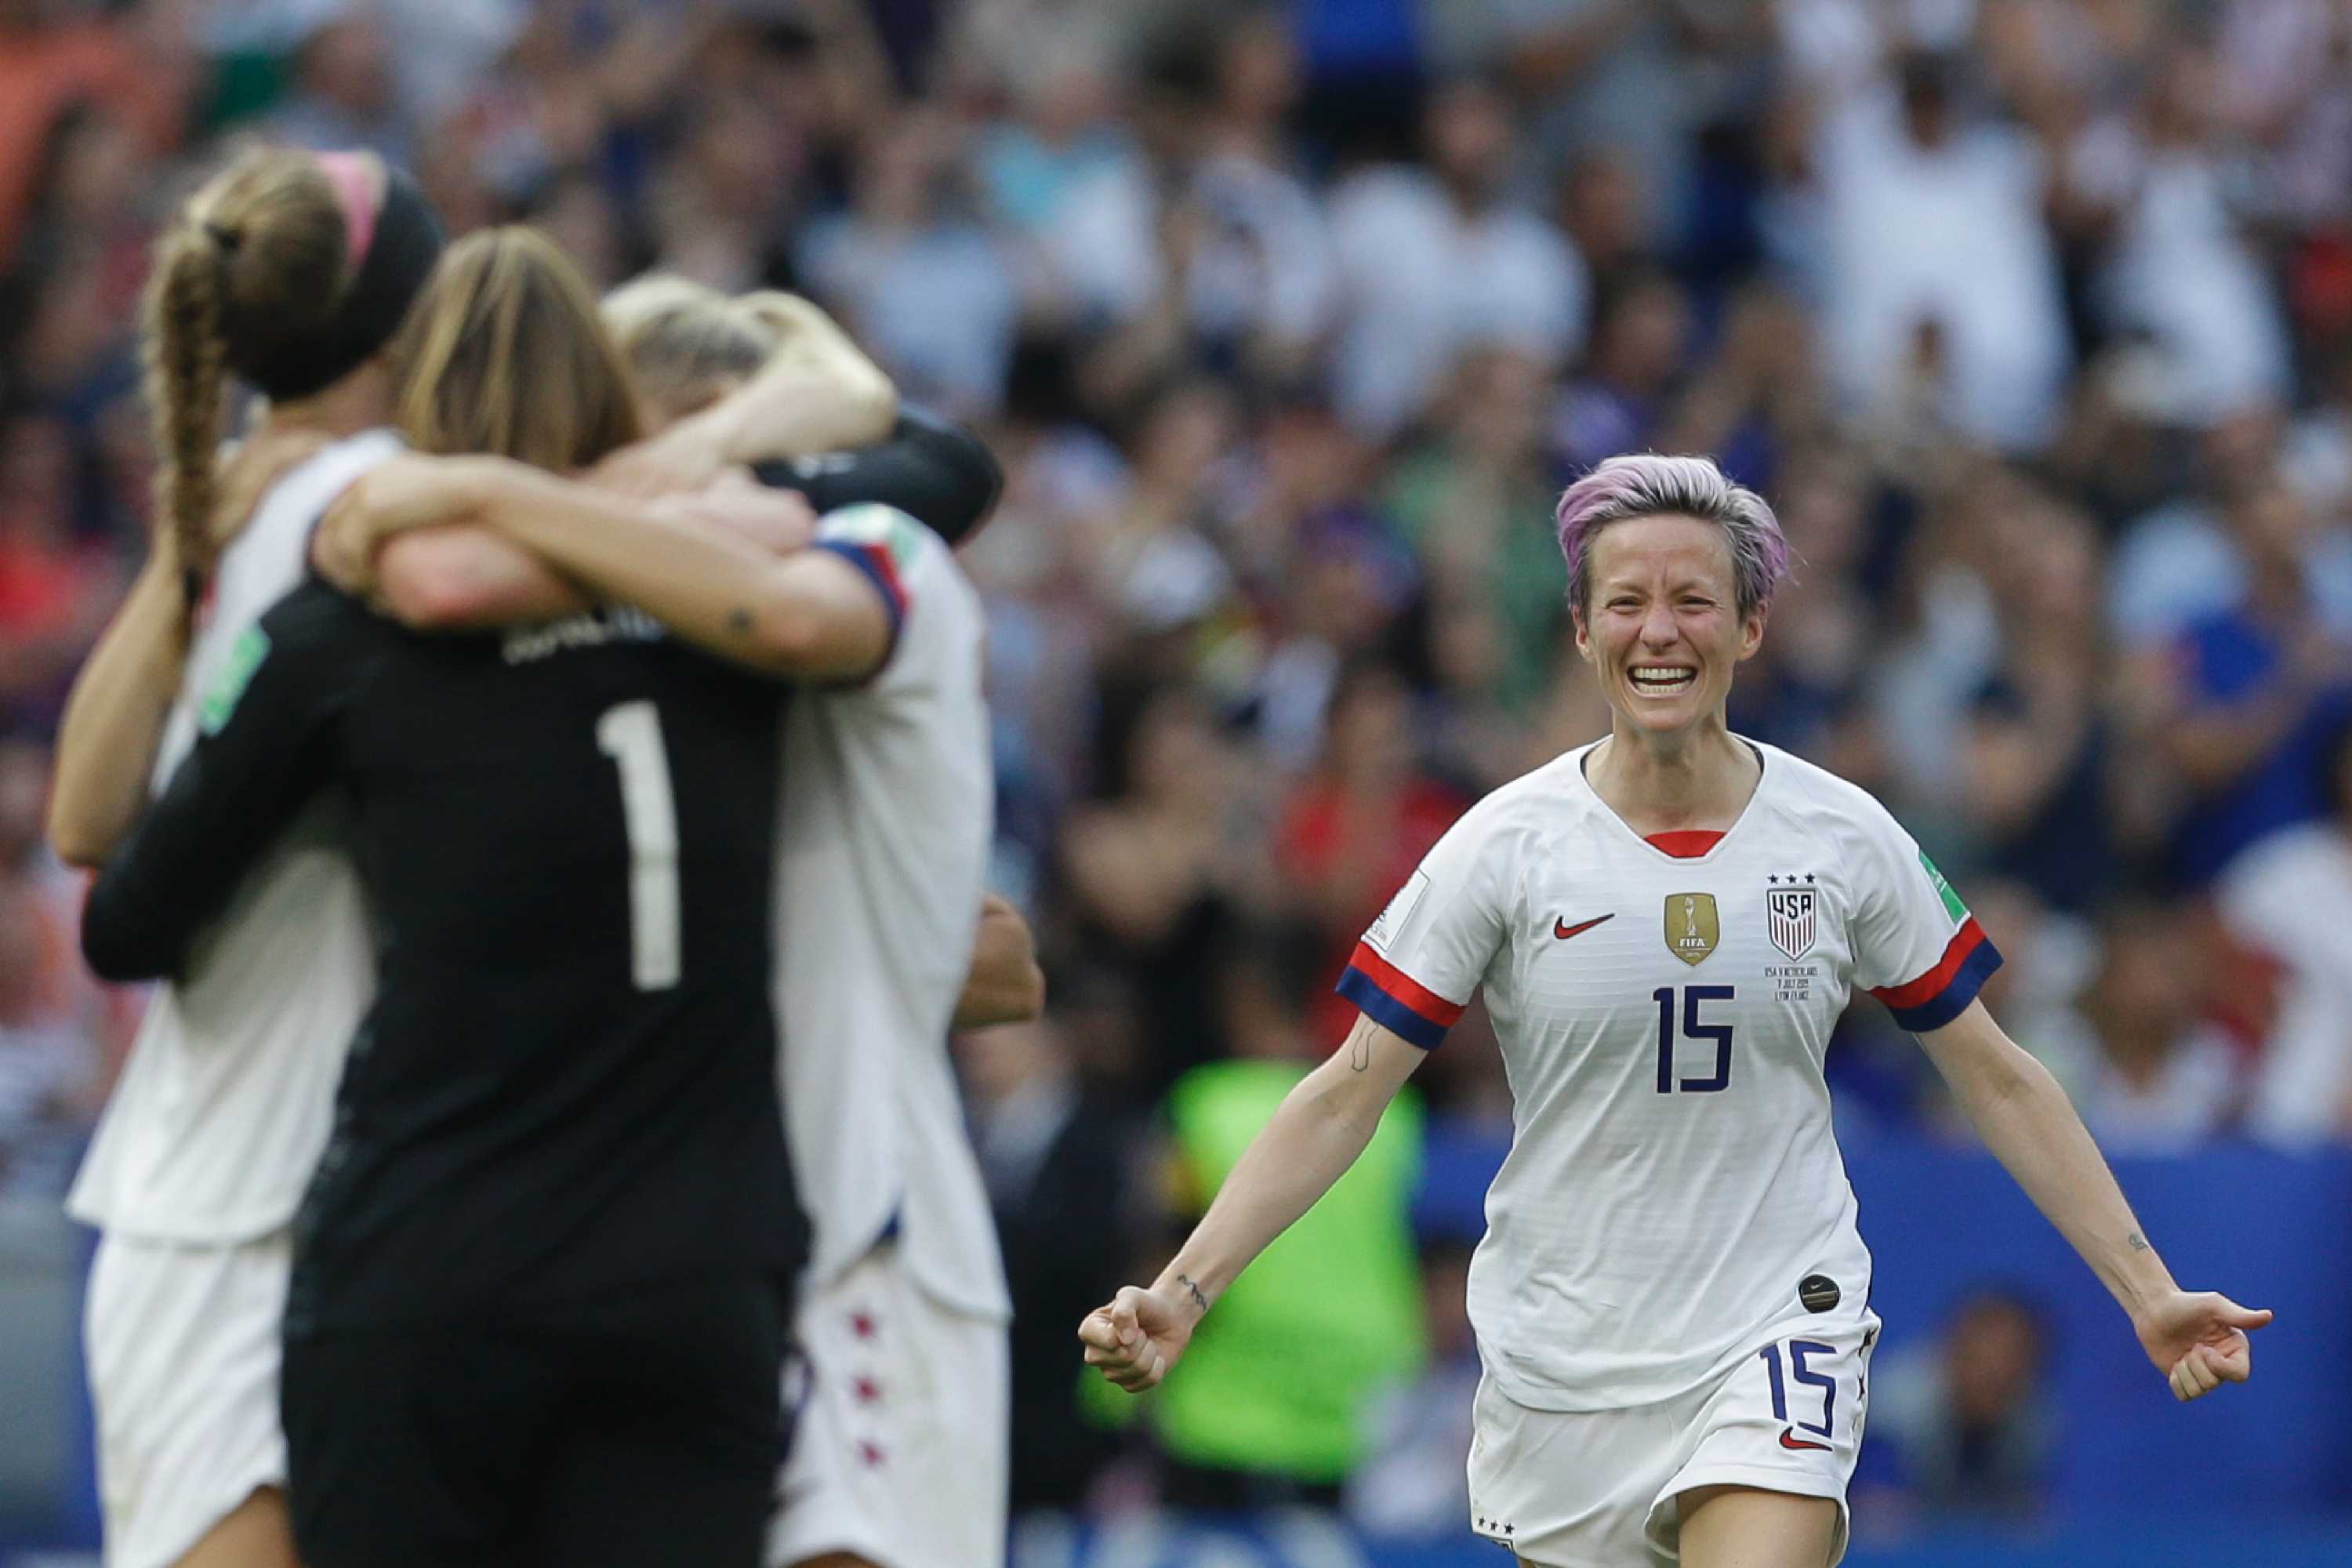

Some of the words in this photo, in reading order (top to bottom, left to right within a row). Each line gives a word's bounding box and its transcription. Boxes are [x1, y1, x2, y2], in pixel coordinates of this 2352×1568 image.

[595, 700, 681, 990] 1
[1679, 938, 1706, 947] FIFA
[1772, 894, 1812, 920] USA
[1653, 985, 1735, 1094] 15
[1759, 1339, 1837, 1439] 15
